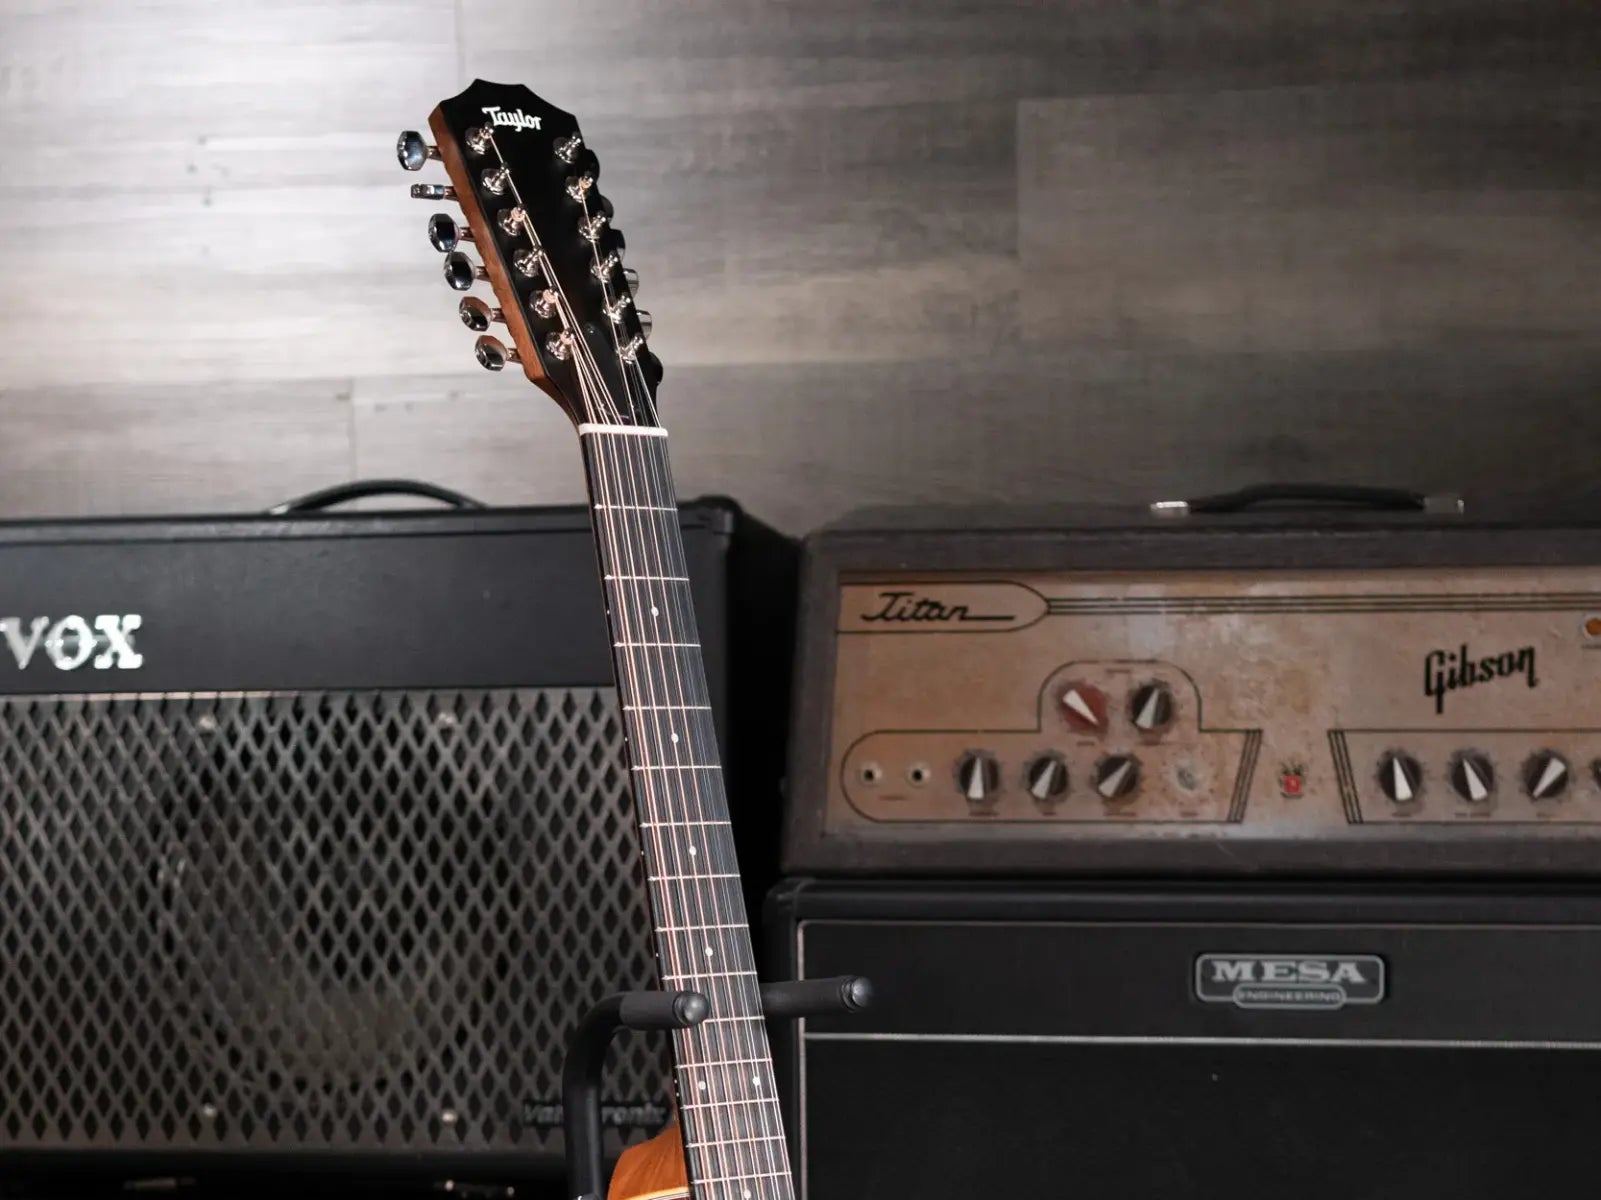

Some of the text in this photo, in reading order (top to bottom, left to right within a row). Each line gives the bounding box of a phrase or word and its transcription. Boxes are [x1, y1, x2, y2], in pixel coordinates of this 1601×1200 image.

[482, 106, 542, 132] Taylor
[861, 591, 1016, 622] Titan
[0, 614, 143, 670] VOX
[1424, 642, 1539, 715] Gibson
[1210, 960, 1367, 984] MESA
[524, 1103, 668, 1125] Valronix
